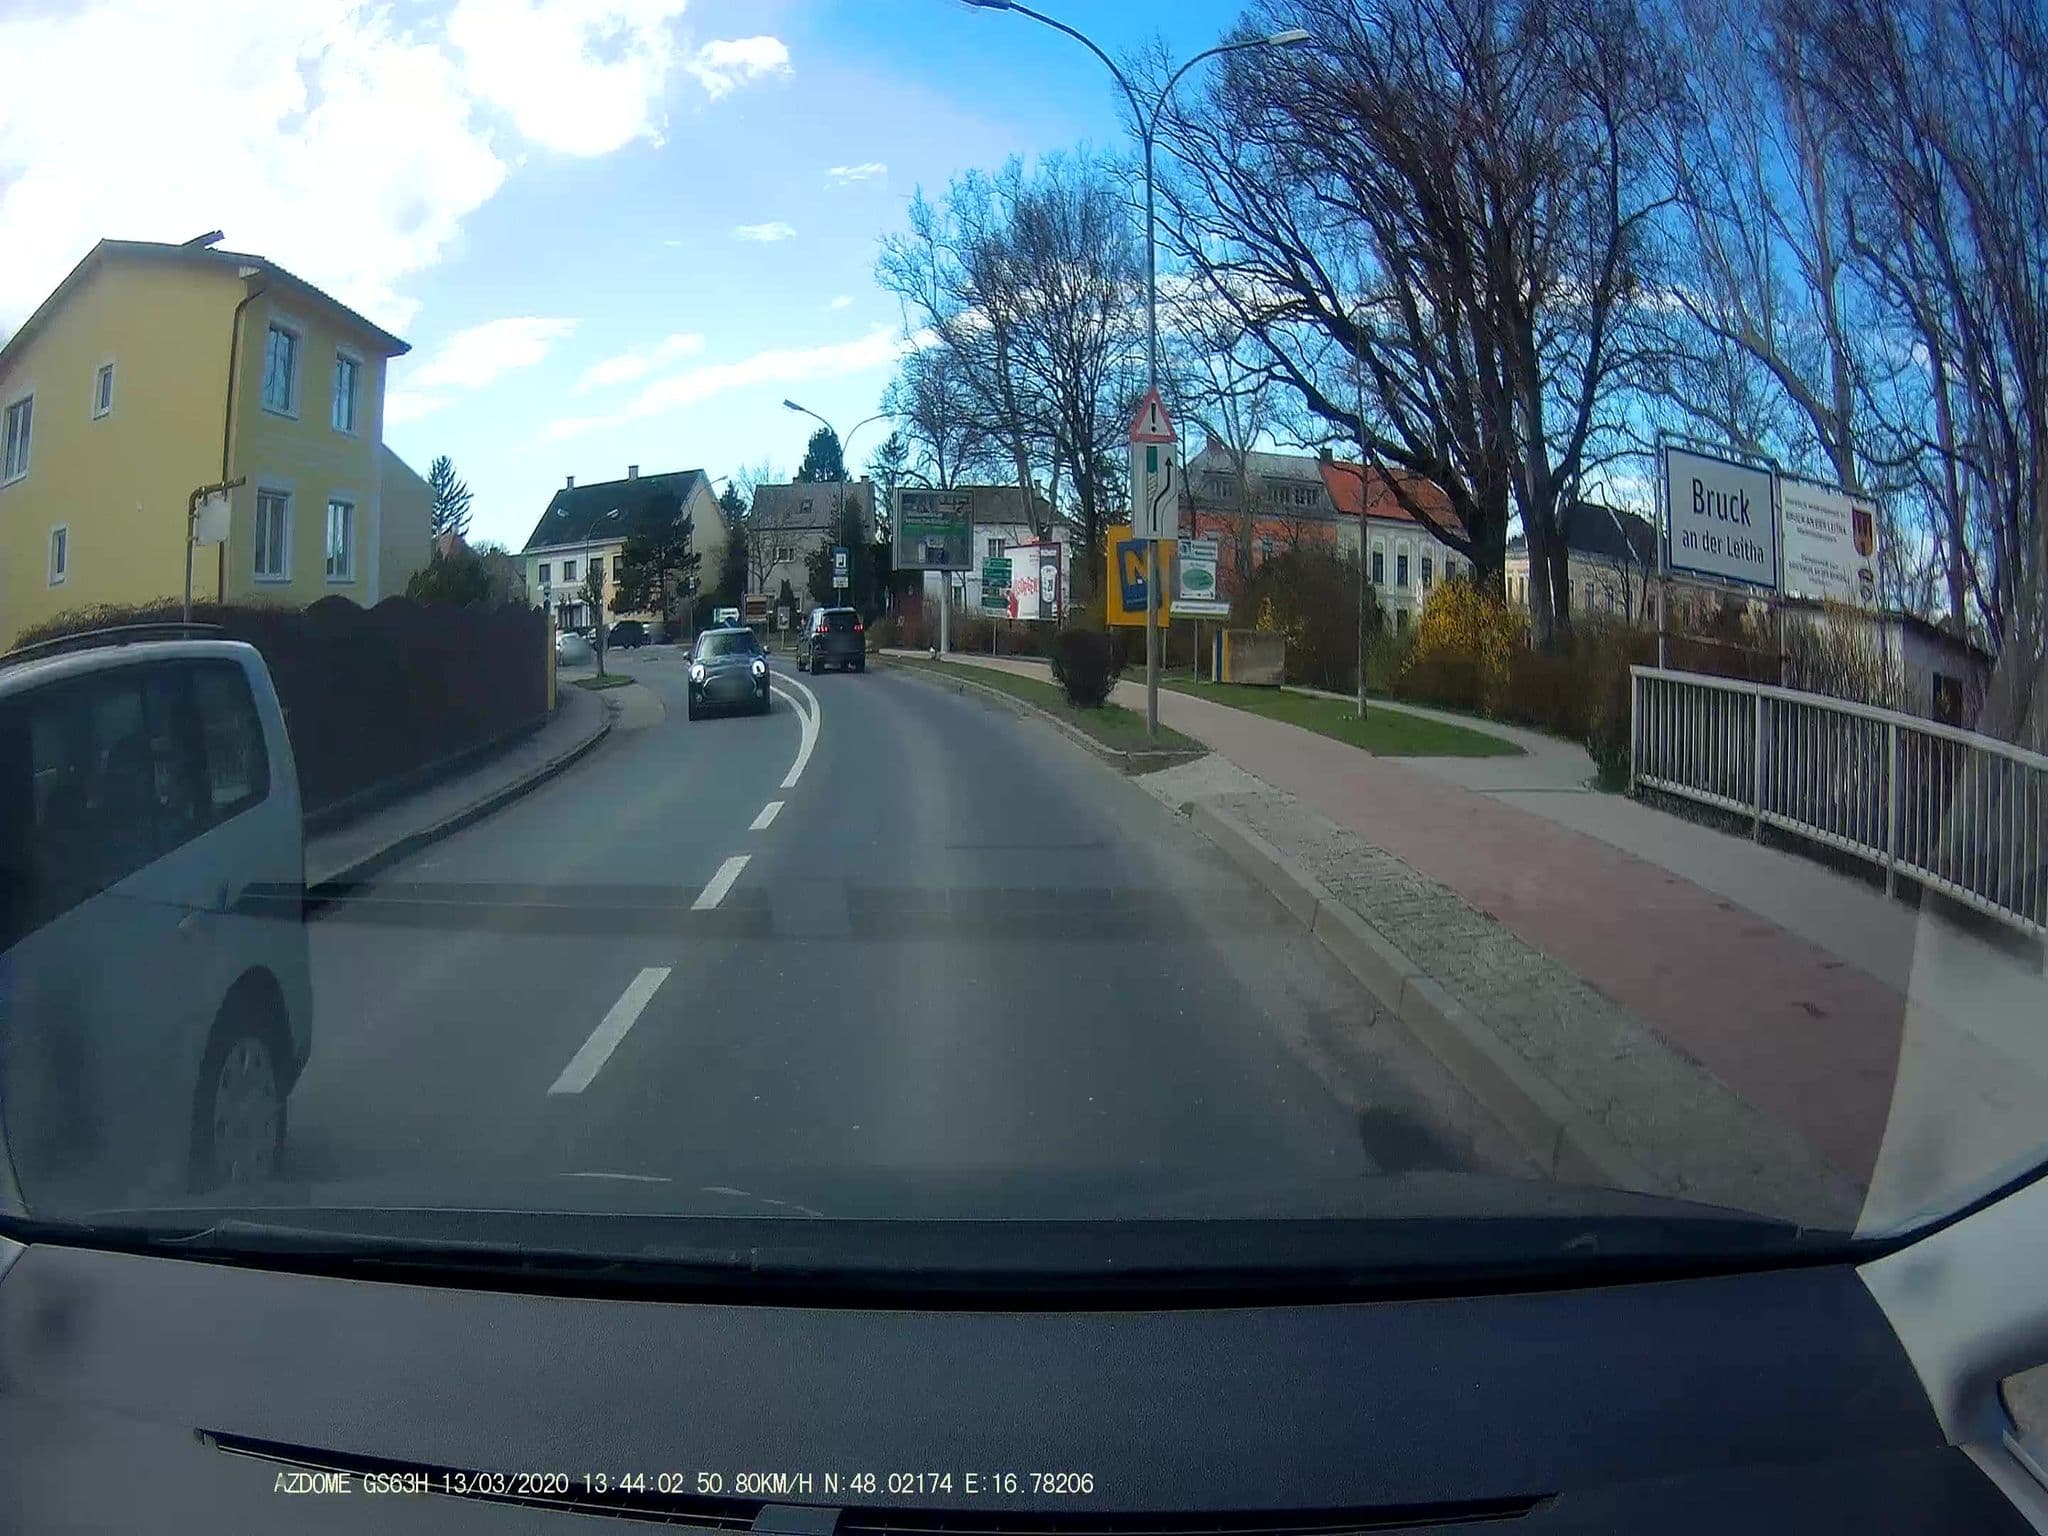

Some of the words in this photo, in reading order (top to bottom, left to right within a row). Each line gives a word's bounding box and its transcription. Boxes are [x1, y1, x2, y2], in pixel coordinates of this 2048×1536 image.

[1692, 477, 1751, 528] Bruck
[1682, 529, 1698, 550] an
[1702, 529, 1723, 555] der
[1727, 534, 1764, 564] Leitha
